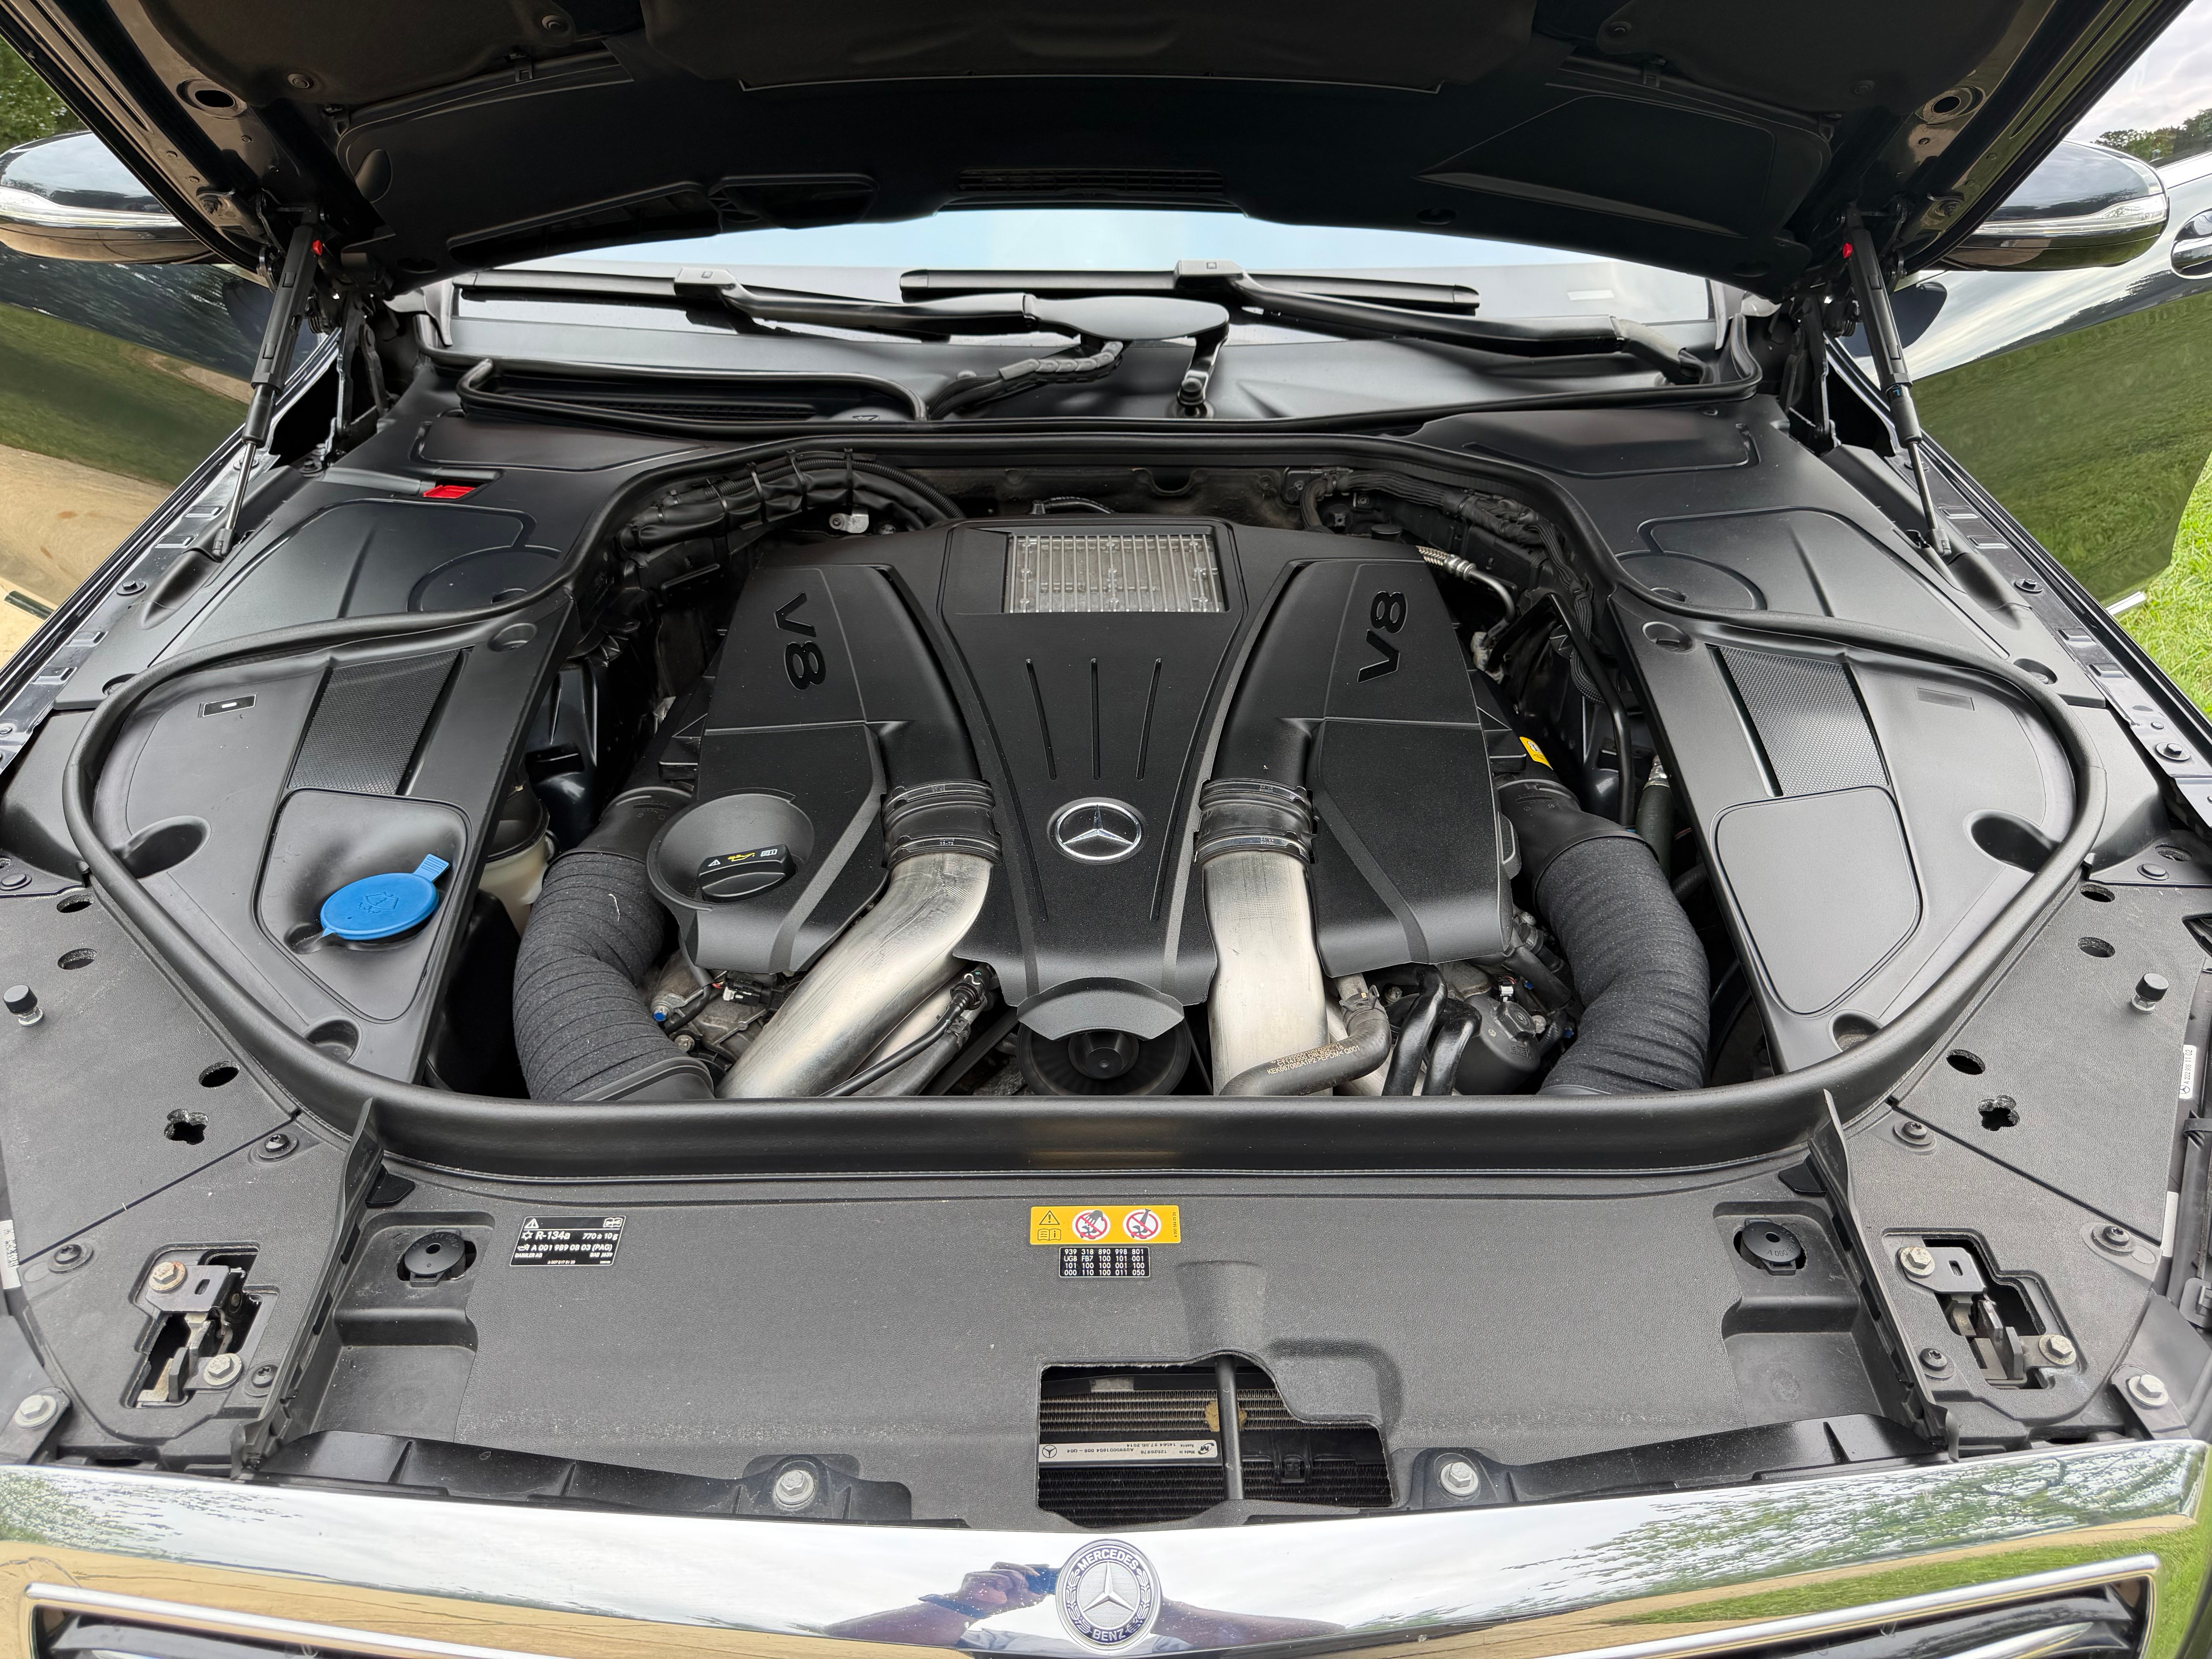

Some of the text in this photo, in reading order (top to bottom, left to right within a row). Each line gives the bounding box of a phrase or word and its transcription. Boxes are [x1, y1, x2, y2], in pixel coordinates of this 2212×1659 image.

[774, 591, 826, 690] V8
[1357, 591, 1408, 683] V8
[1344, 1045, 1360, 1054] Q001
[1277, 1055, 1307, 1066] CT147300
[535, 1231, 571, 1240] R-134a
[1078, 1549, 1139, 1571] MERCEDES
[1093, 1628, 1126, 1642] BENZ
